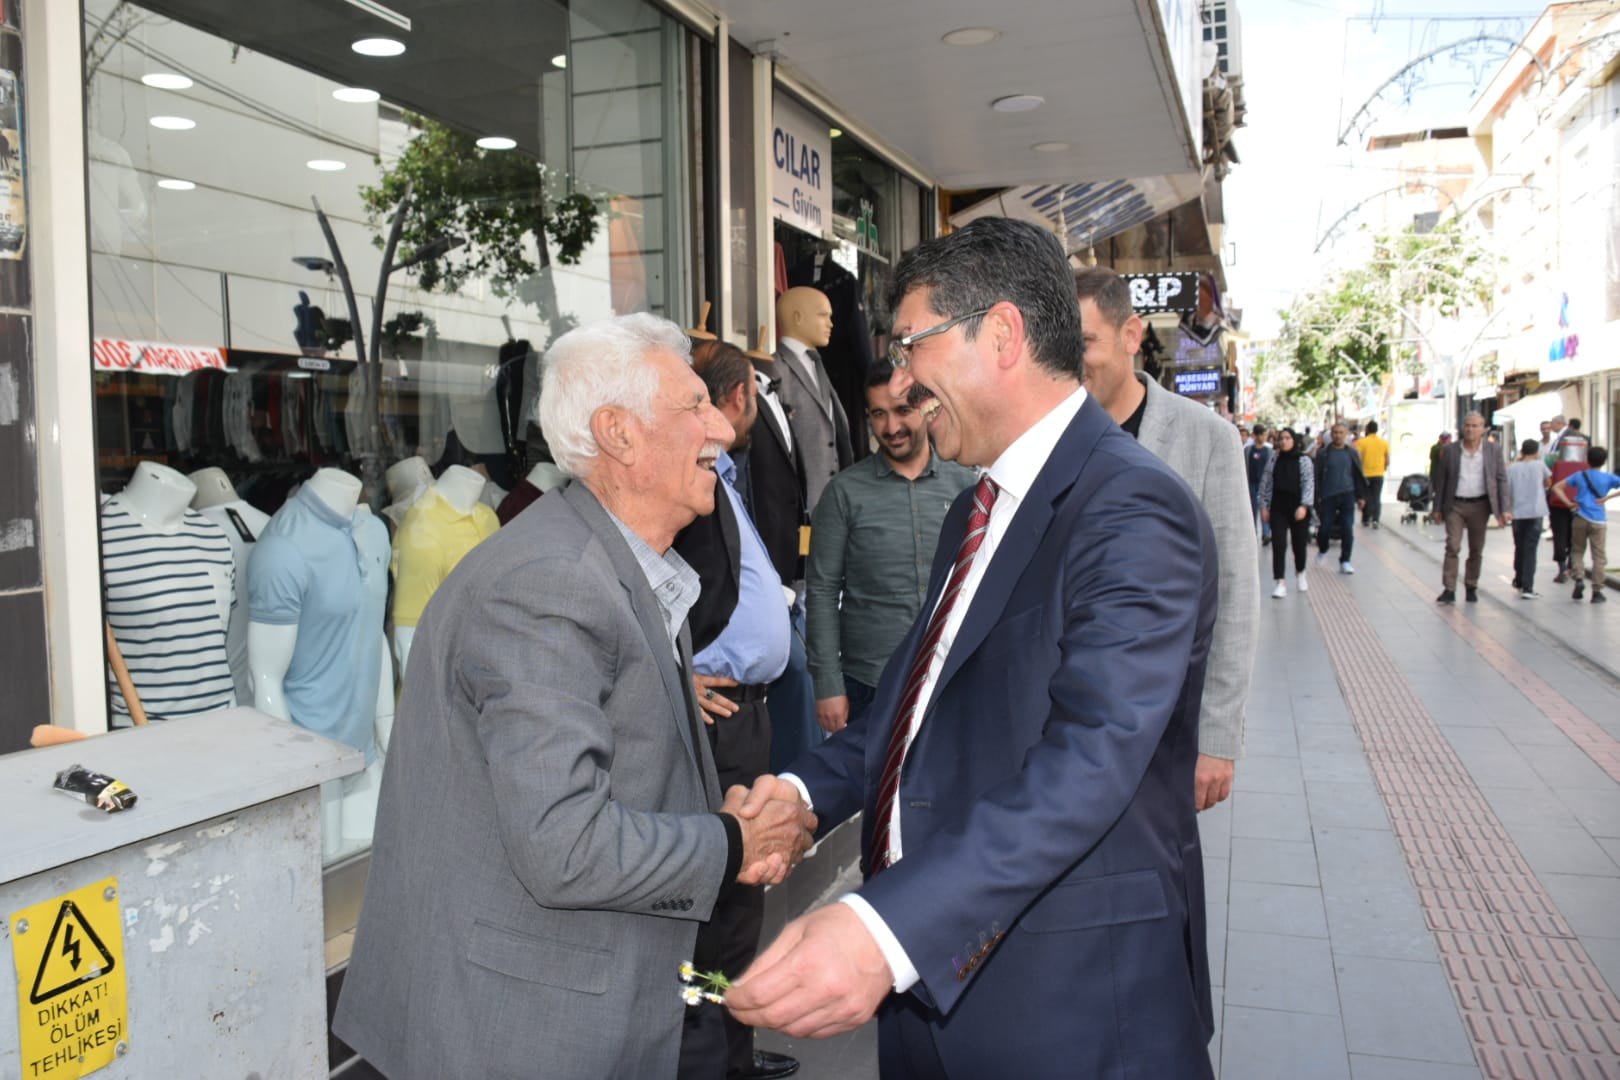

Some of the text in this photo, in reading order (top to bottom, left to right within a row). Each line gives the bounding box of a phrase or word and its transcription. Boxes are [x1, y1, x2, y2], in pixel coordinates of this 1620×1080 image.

[773, 127, 821, 190] CILAR
[792, 187, 822, 225] Giyim
[1175, 372, 1218, 384] AKSESUAR
[38, 982, 108, 1026] DİKKAT!
[50, 1008, 100, 1044] ÖLÜM
[30, 1018, 121, 1076] TEHLİKESİ
